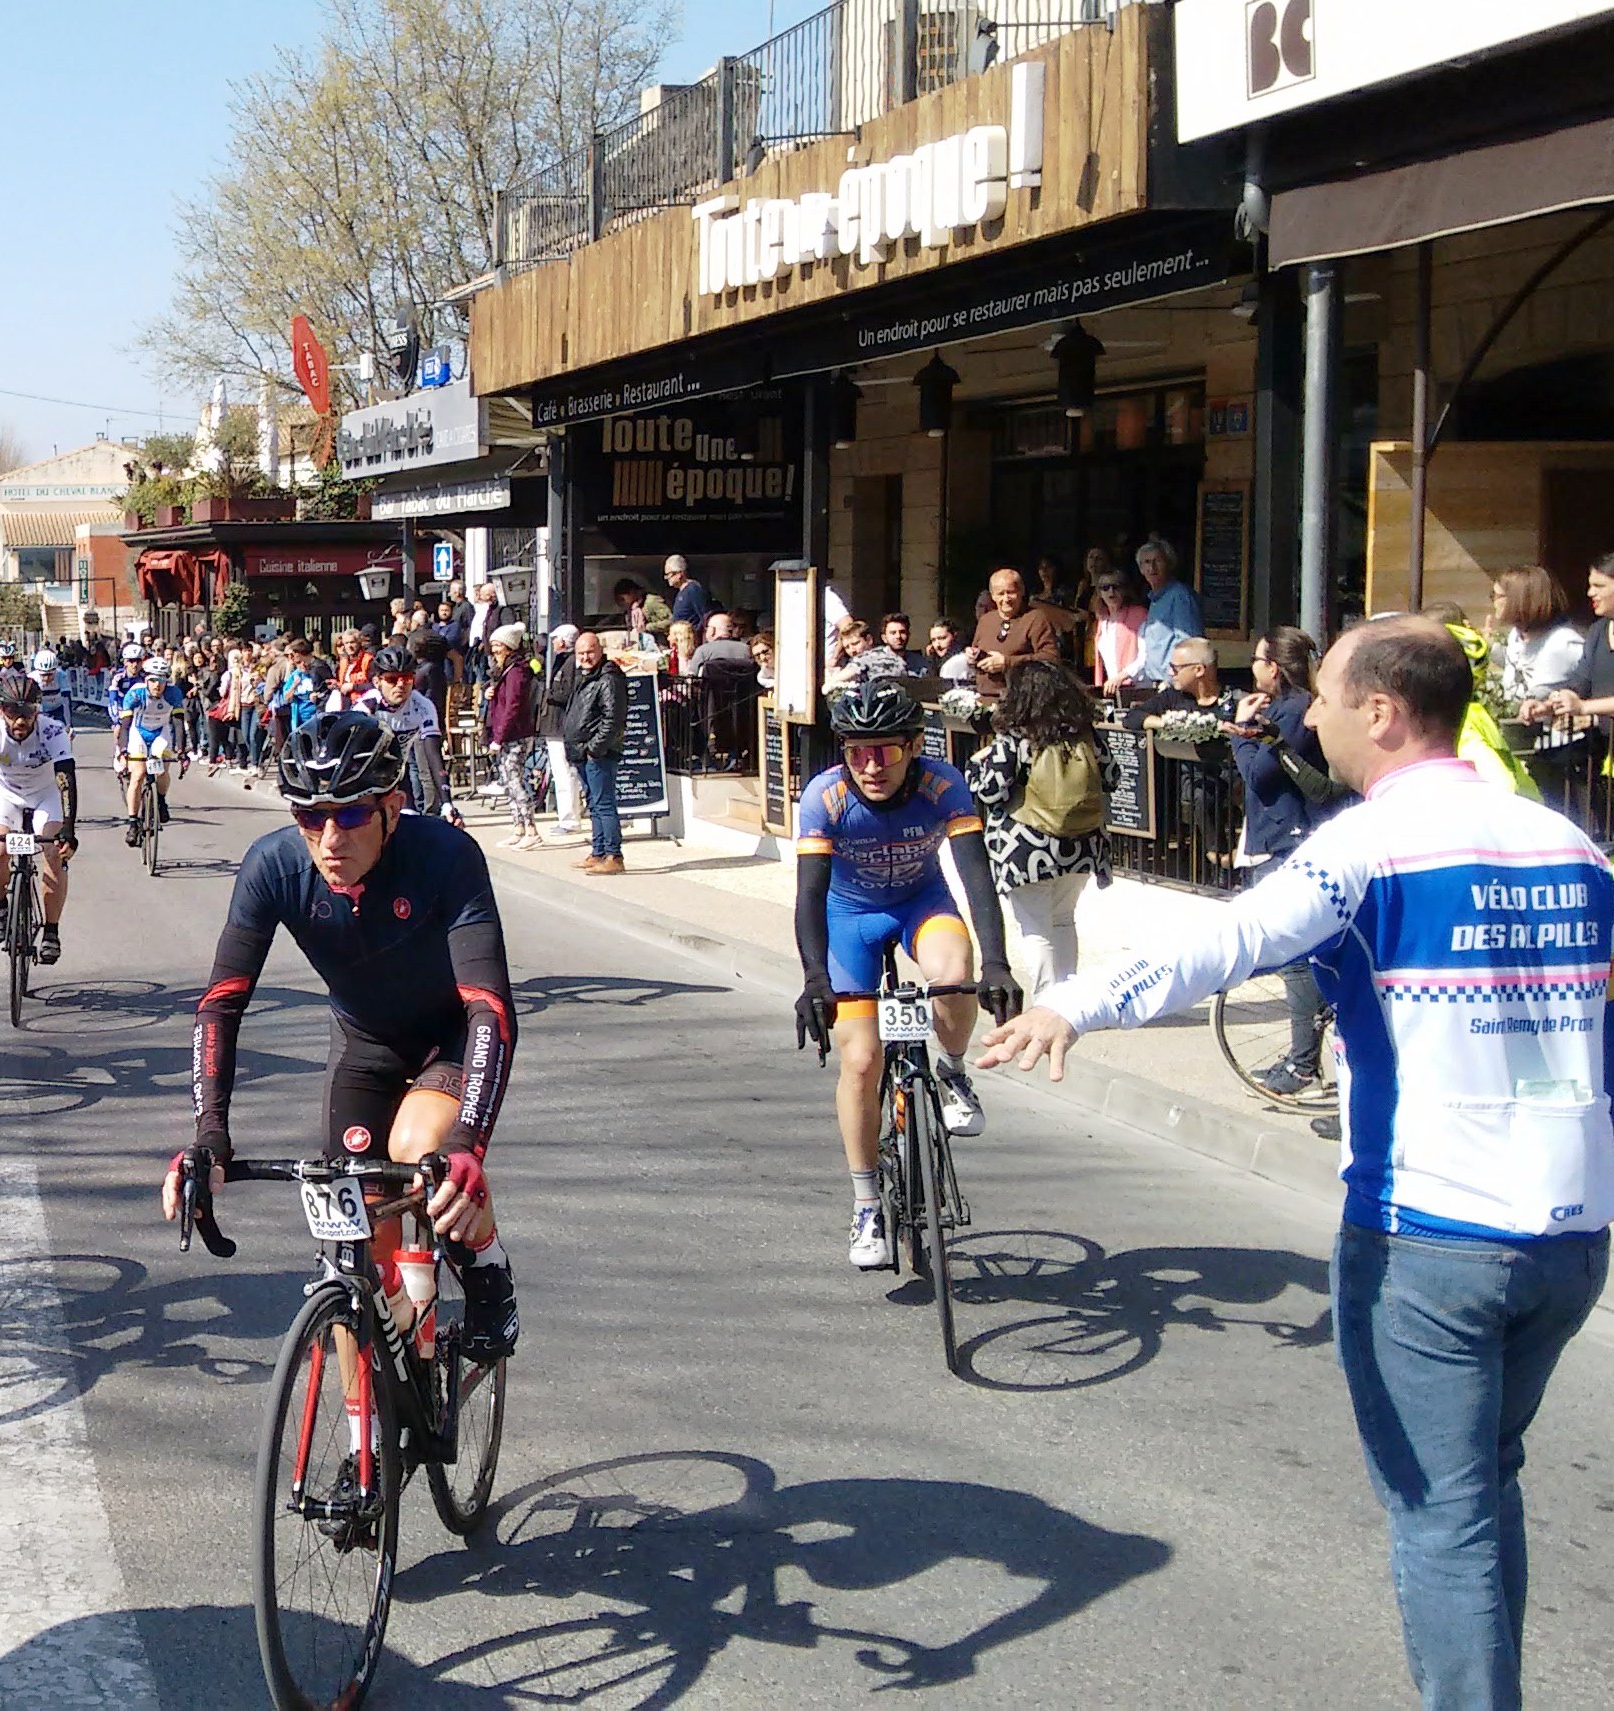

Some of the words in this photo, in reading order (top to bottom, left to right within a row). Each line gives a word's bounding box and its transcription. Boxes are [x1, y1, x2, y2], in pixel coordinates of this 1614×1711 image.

[692, 195, 790, 297] Toute
[858, 328, 875, 347] Un
[876, 319, 919, 345] endroit
[920, 312, 951, 340] pour
[952, 310, 968, 328] se
[969, 295, 1032, 326] restaurer
[1033, 280, 1069, 307] mais
[1071, 277, 1100, 303] pas
[1103, 249, 1193, 291] seulement
[302, 342, 321, 387] TABAC
[537, 402, 558, 424] Café
[567, 388, 613, 417] Brasserie
[622, 372, 684, 407] Restaurant
[601, 414, 693, 454] Toute
[695, 433, 739, 463] une
[259, 558, 294, 574] Cuisine
[297, 559, 338, 573] italienne
[8, 836, 32, 847] 424
[901, 825, 925, 837] PFM
[1470, 878, 1527, 911] VÉLO
[1530, 883, 1588, 911] CLUB
[1450, 923, 1507, 951] DES
[885, 1004, 927, 1026] 350
[1541, 1017, 1557, 1032] de
[471, 1025, 492, 1069] GRAND
[460, 1071, 485, 1128] TROPHÉE
[305, 1187, 358, 1220] 876
